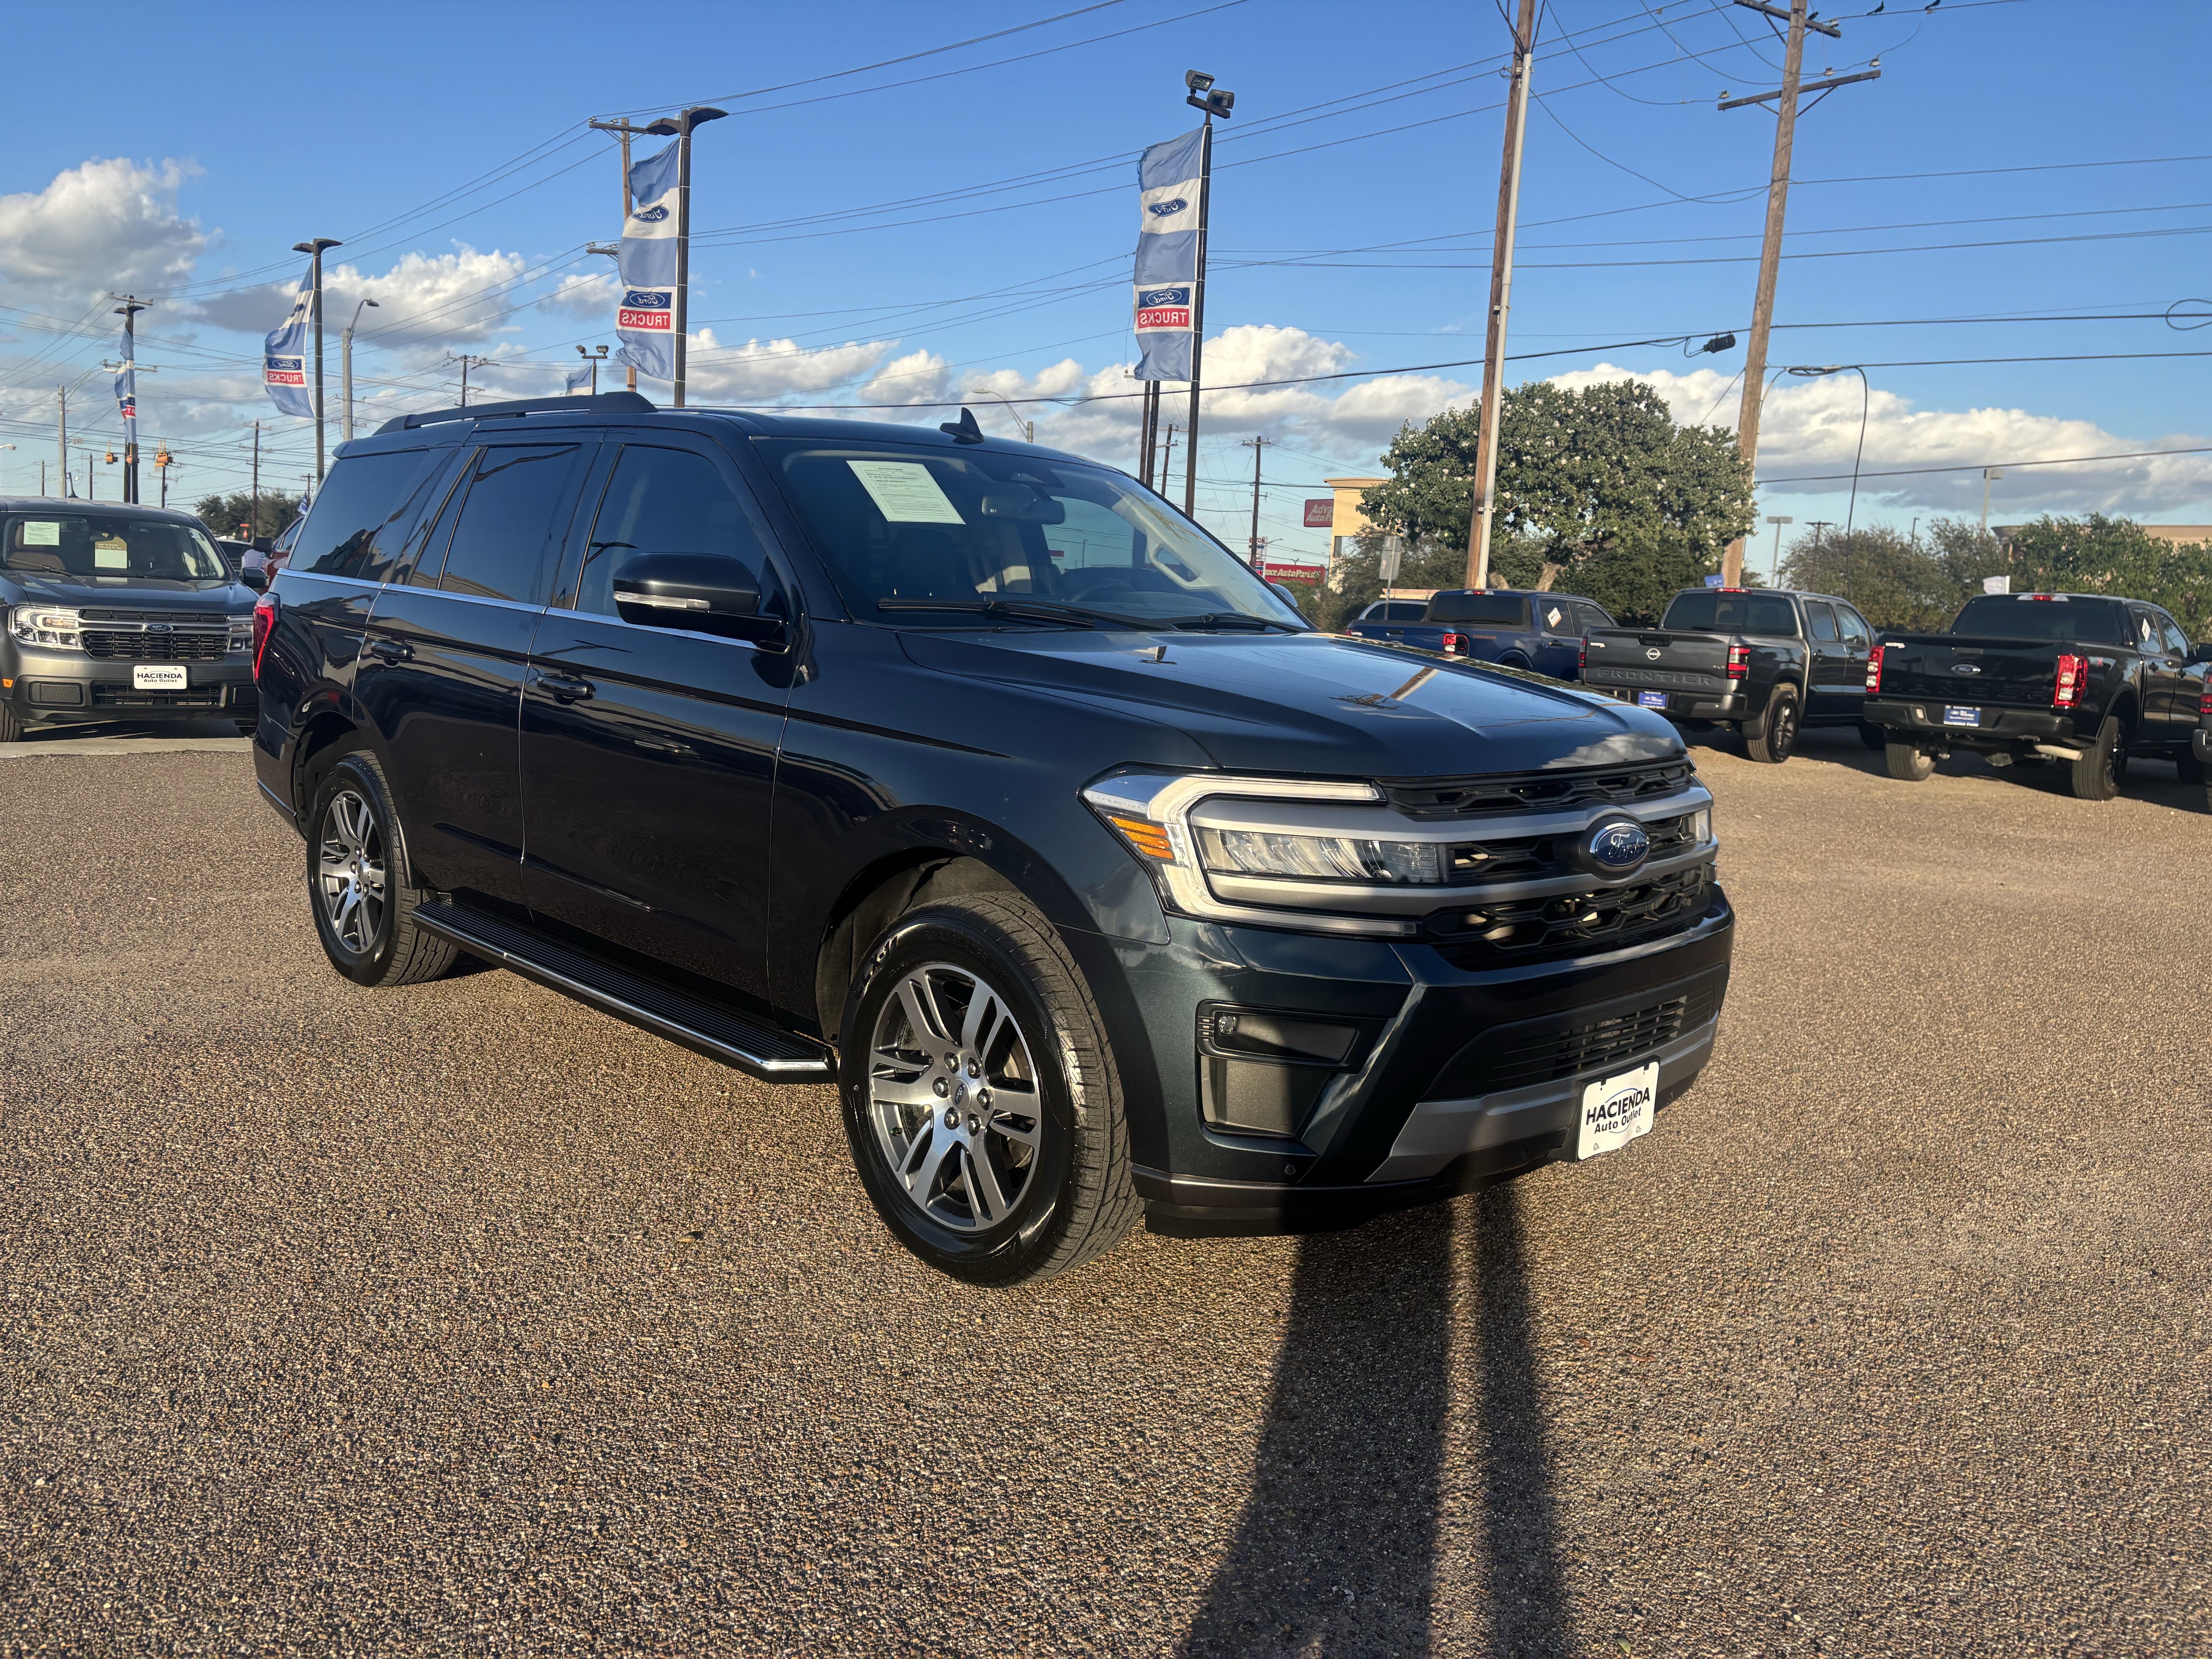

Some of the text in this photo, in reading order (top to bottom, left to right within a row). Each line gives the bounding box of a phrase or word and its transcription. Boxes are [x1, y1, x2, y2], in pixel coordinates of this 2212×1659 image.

[1277, 568, 1296, 577] Auto
[1597, 668, 1712, 685] FRONTIER
[1609, 833, 1645, 859] Ford
[1586, 1087, 1650, 1125] HACIENDA
[1594, 1107, 1641, 1134] Auto Outlet
